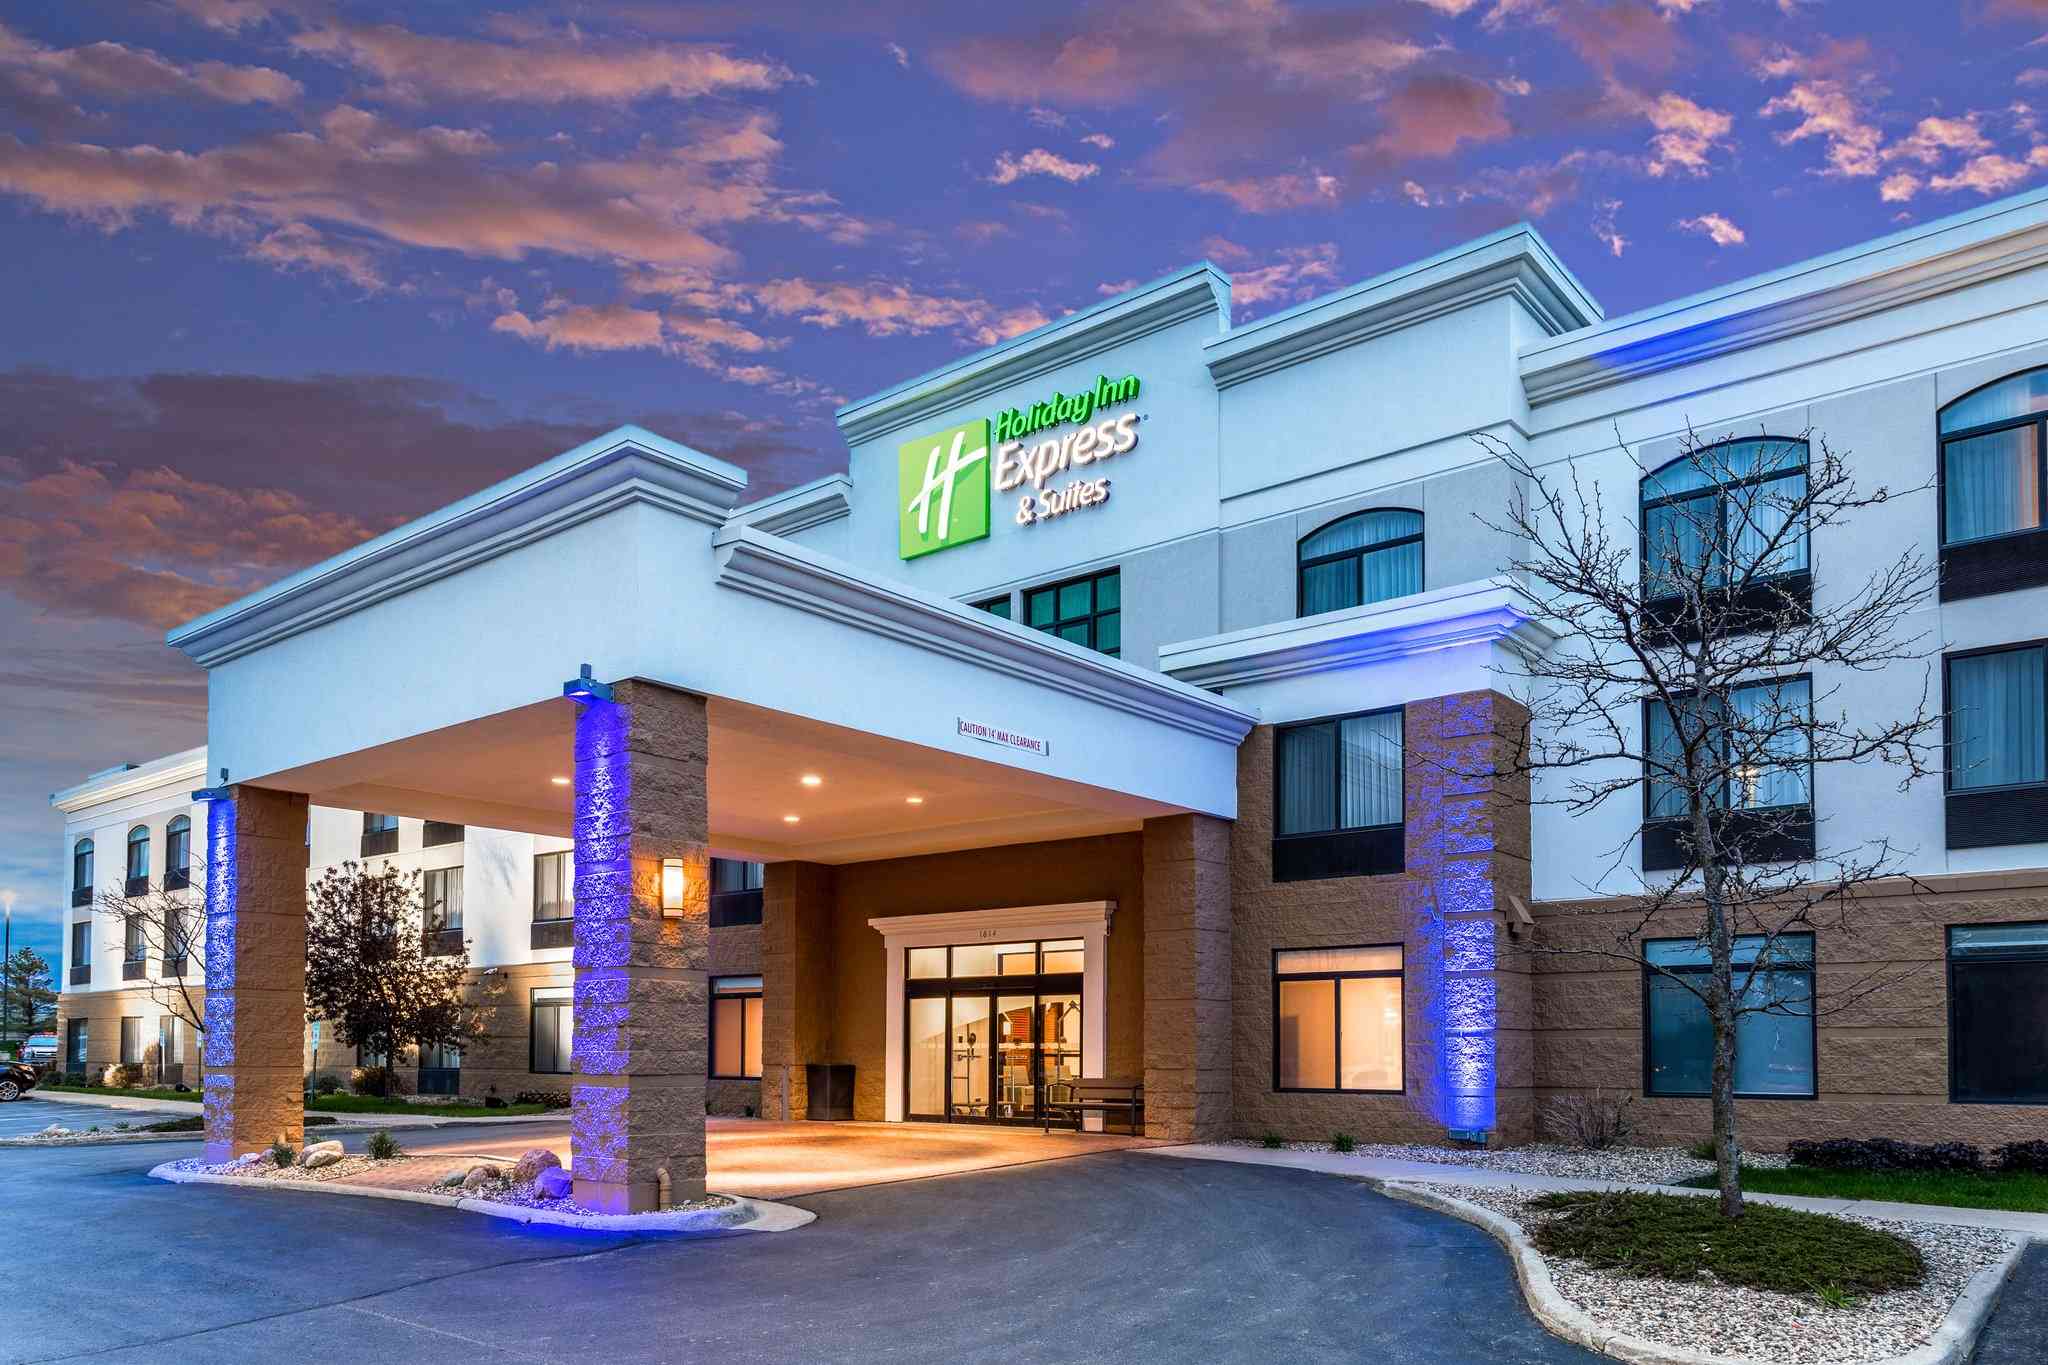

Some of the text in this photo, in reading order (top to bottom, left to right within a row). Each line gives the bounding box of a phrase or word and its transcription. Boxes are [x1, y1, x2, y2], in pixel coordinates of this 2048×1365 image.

[994, 375, 1140, 442] Holiday Inn
[994, 412, 1140, 490] Express
[1015, 478, 1111, 526] & Suites
[960, 721, 986, 737] CAUTION
[997, 730, 1008, 742] MAX
[1010, 734, 1040, 751] CLEARANCE
